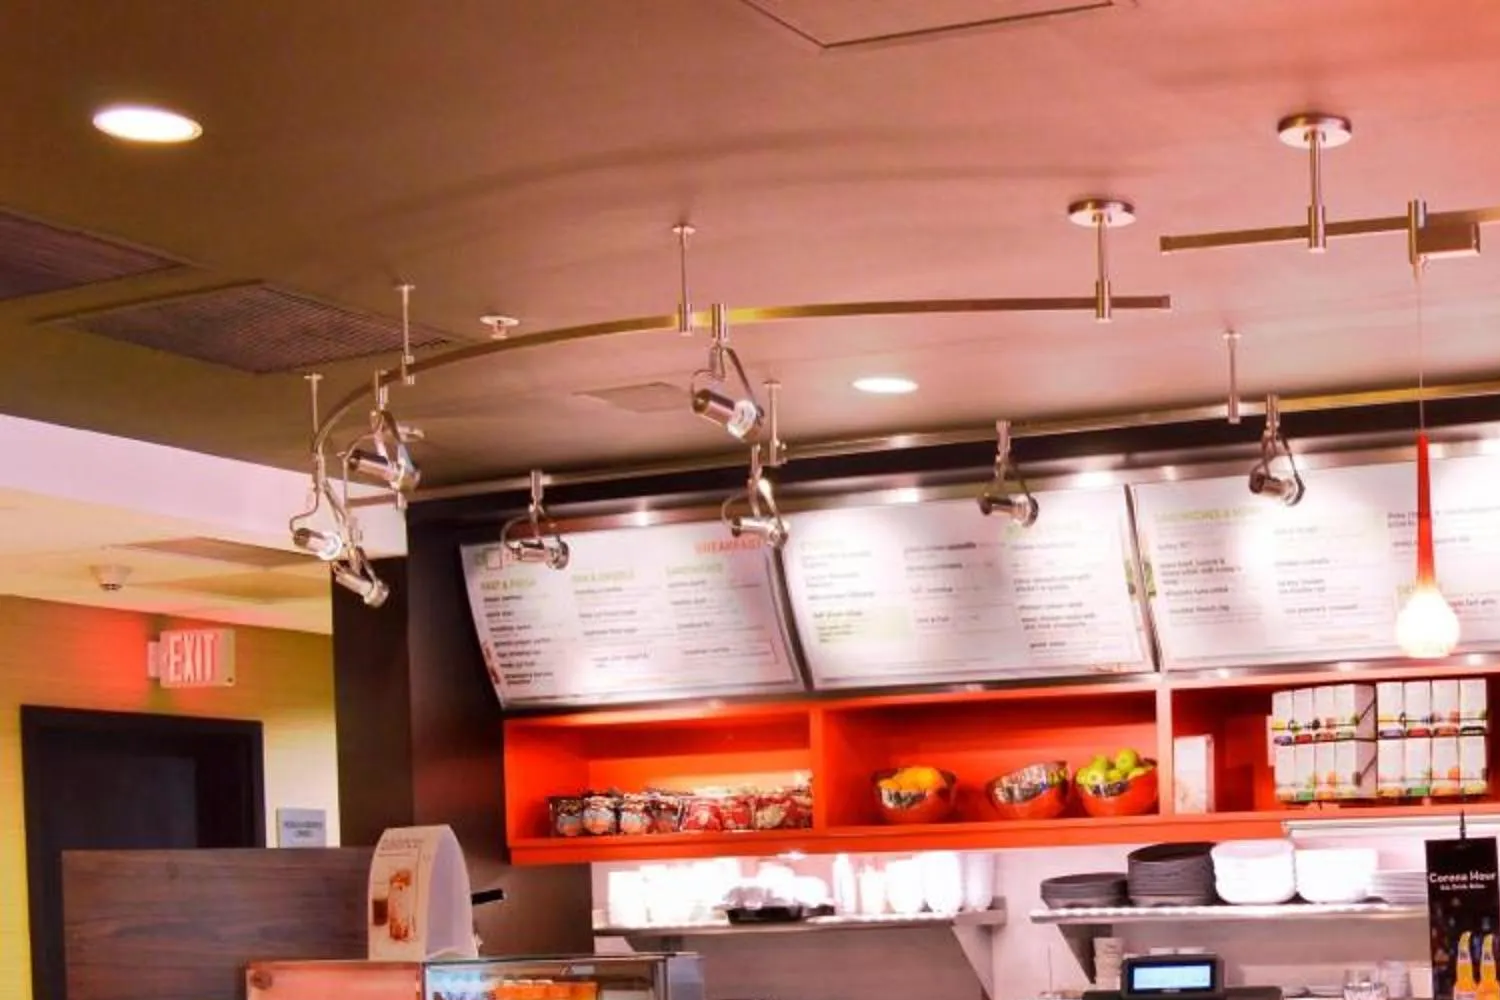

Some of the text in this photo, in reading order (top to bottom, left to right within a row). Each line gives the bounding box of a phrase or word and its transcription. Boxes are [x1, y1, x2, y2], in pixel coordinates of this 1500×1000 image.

[168, 634, 215, 683] EXIT
[1429, 870, 1496, 883] Corona Hour
